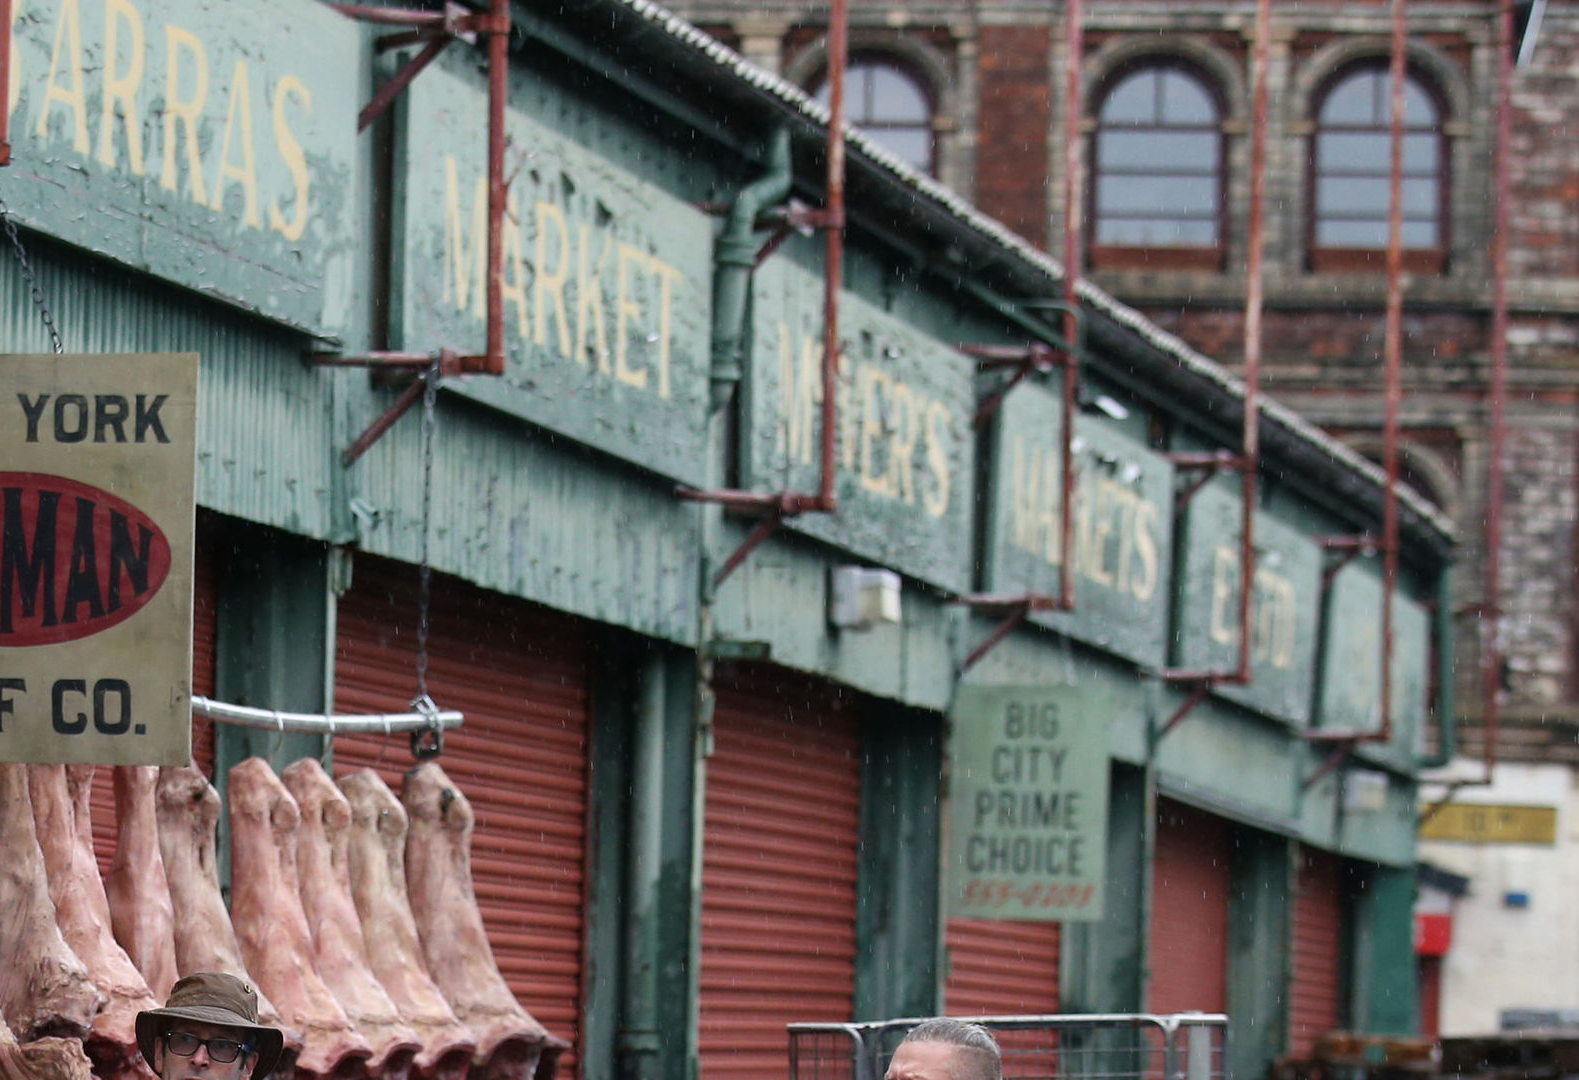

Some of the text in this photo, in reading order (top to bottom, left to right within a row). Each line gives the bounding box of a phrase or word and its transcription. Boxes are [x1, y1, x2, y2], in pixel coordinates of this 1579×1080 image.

[443, 155, 683, 401] MARKET
[17, 393, 171, 444] YORK
[51, 678, 146, 735] CO.
[1005, 701, 1059, 740] BIG
[992, 745, 1069, 784] CITY
[974, 790, 1082, 831] PRIME
[966, 834, 1084, 876] CHOICE
